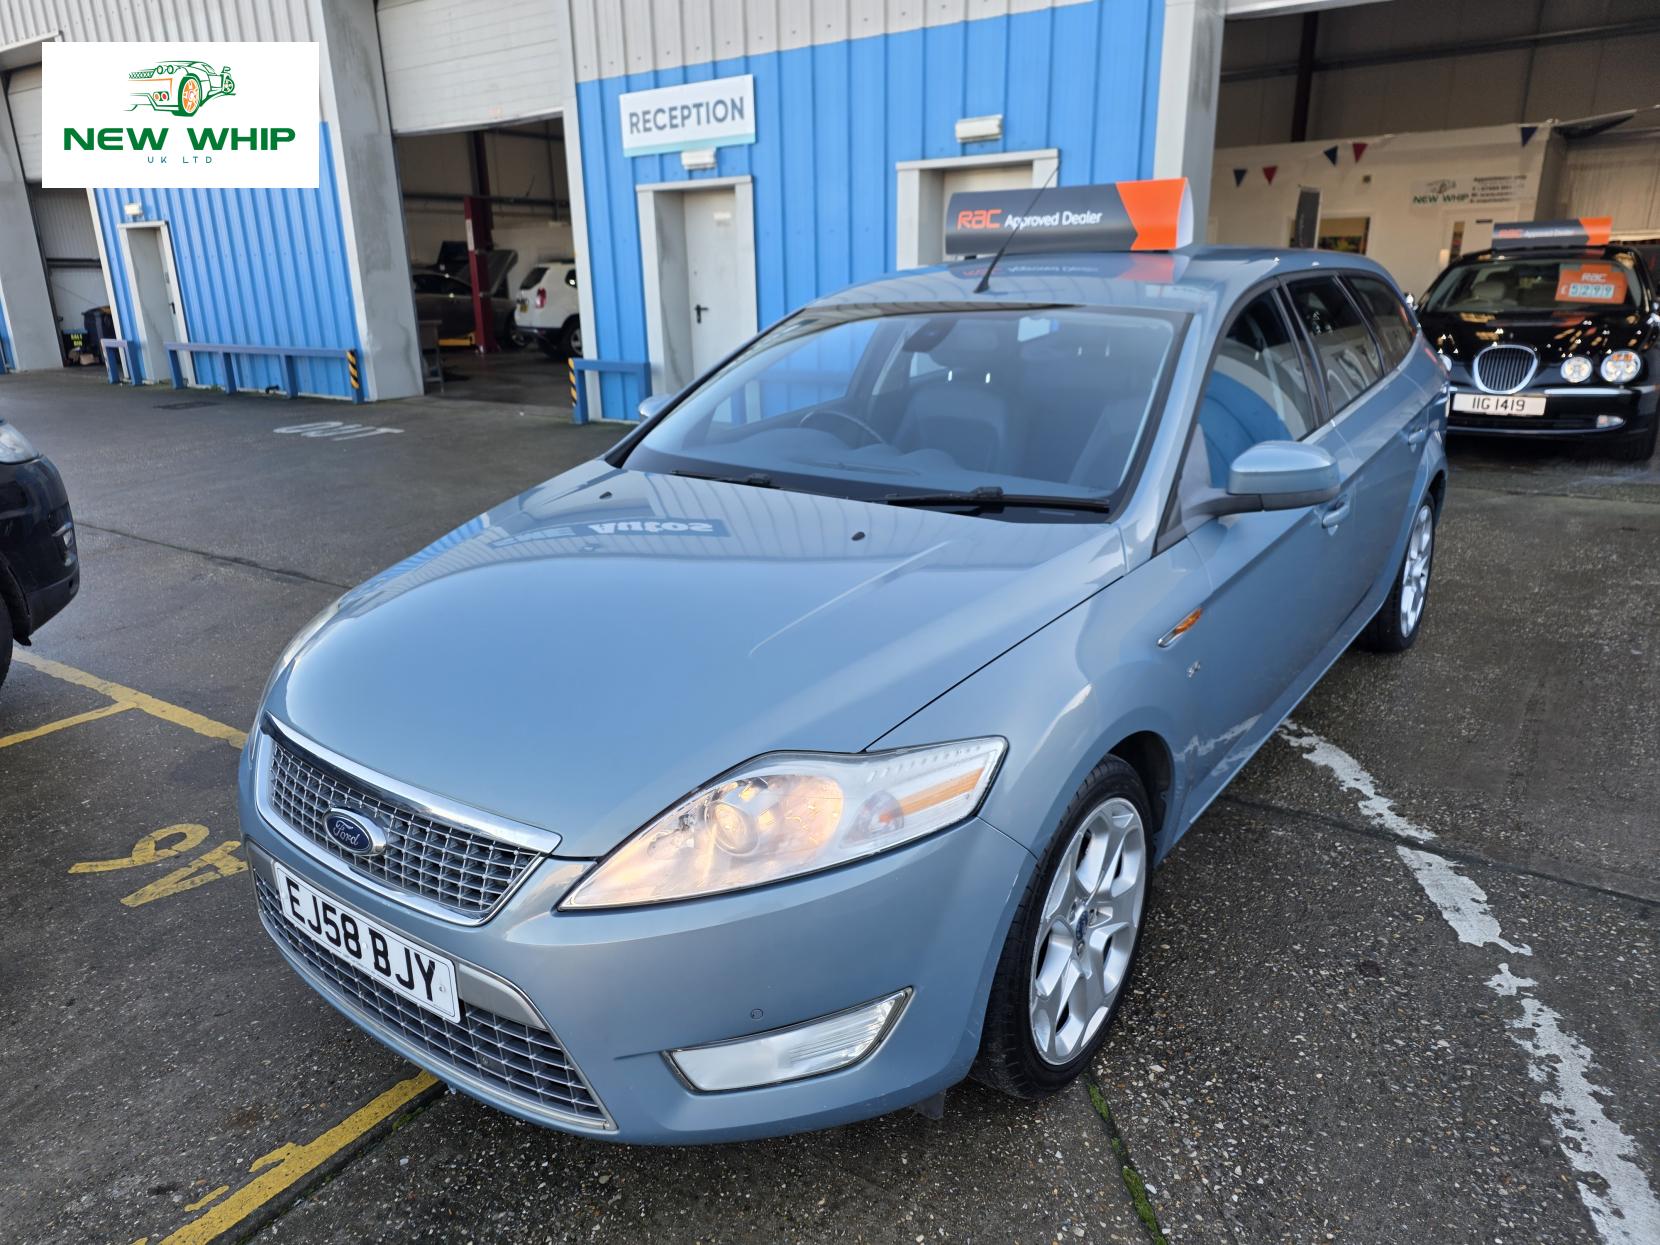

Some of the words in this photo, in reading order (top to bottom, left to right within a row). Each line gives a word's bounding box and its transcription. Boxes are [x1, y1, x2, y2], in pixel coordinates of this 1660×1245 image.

[629, 96, 745, 135] RECEPTION
[1413, 194, 1439, 204] NEW
[1443, 193, 1469, 202] WHIP
[1004, 211, 1060, 230] Approved
[1062, 209, 1103, 226] Dealer
[1495, 398, 1526, 412] 1419
[273, 421, 405, 441] OUT
[332, 819, 360, 847] Ford
[286, 876, 363, 960] EJ58
[368, 927, 436, 1002] BJY
